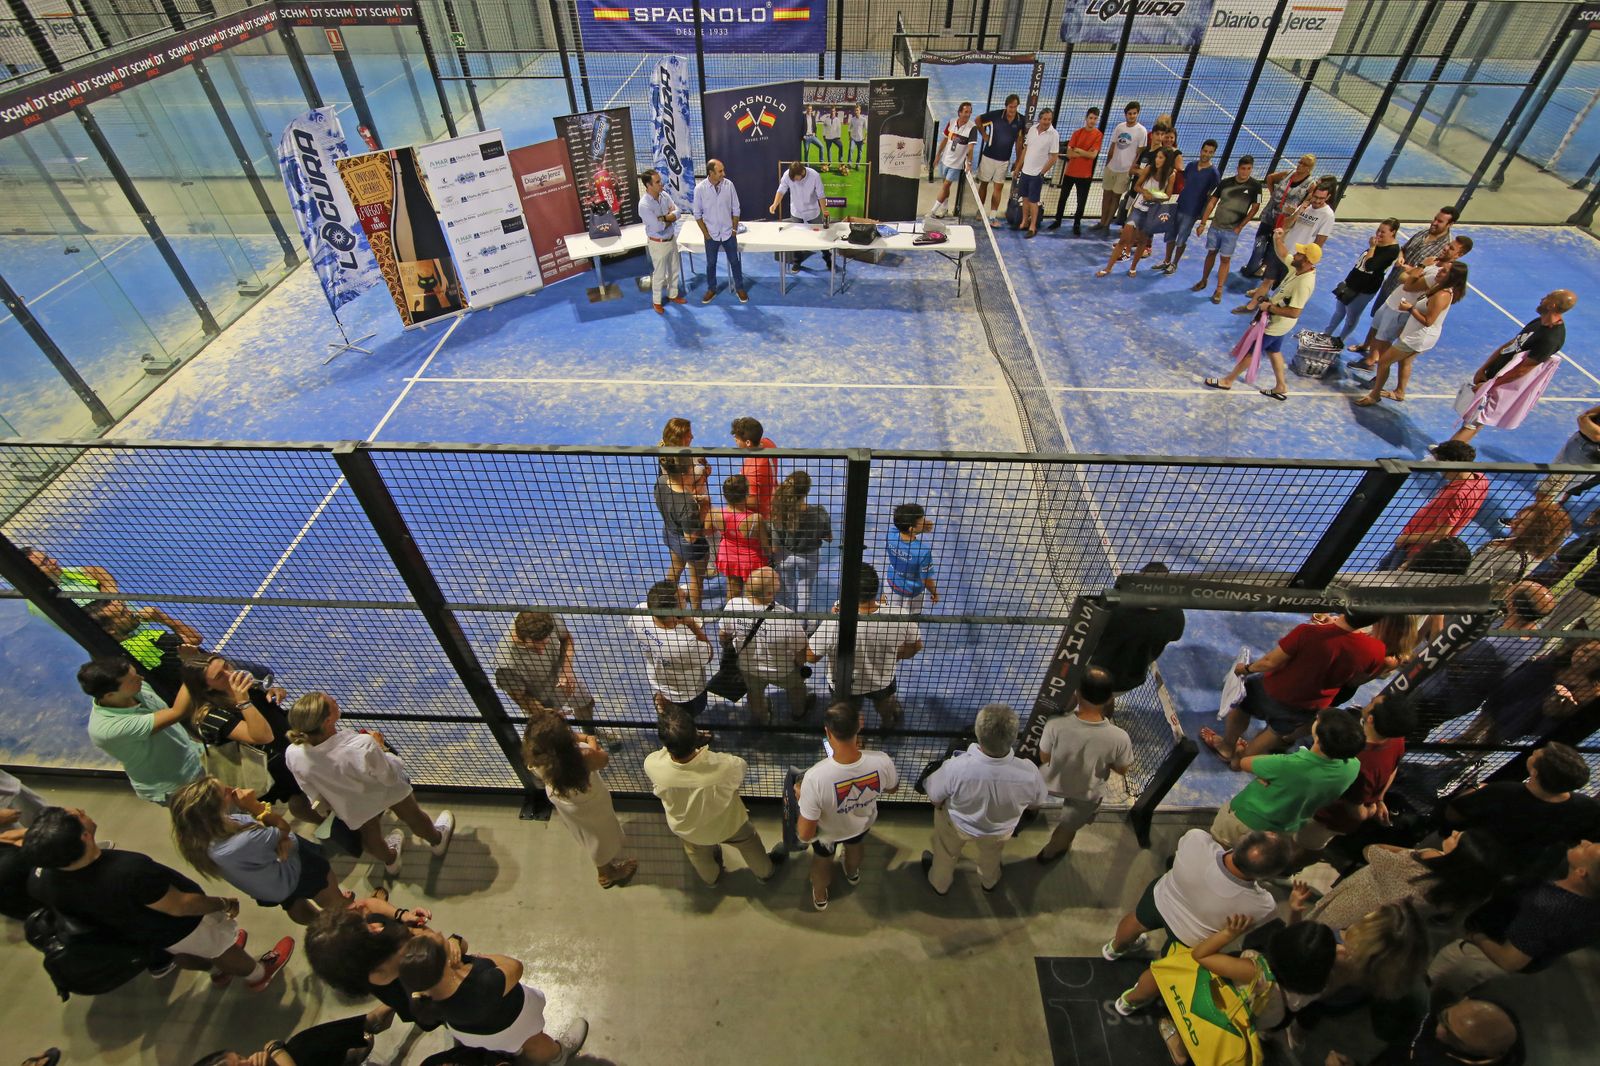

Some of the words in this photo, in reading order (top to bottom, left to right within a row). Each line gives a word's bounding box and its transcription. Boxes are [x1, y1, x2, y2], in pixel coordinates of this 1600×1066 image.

[634, 7, 766, 23] SPAGNOLO
[1212, 10, 1259, 28] Diario
[1281, 12, 1326, 35] Jerez
[676, 28, 704, 36] DESE
[709, 28, 728, 36] 1933
[723, 95, 787, 121] SPAGNOLO
[293, 128, 359, 270] LOCURA
[1191, 587, 1262, 602] COCINAS
[1169, 984, 1200, 1047] HEAD
